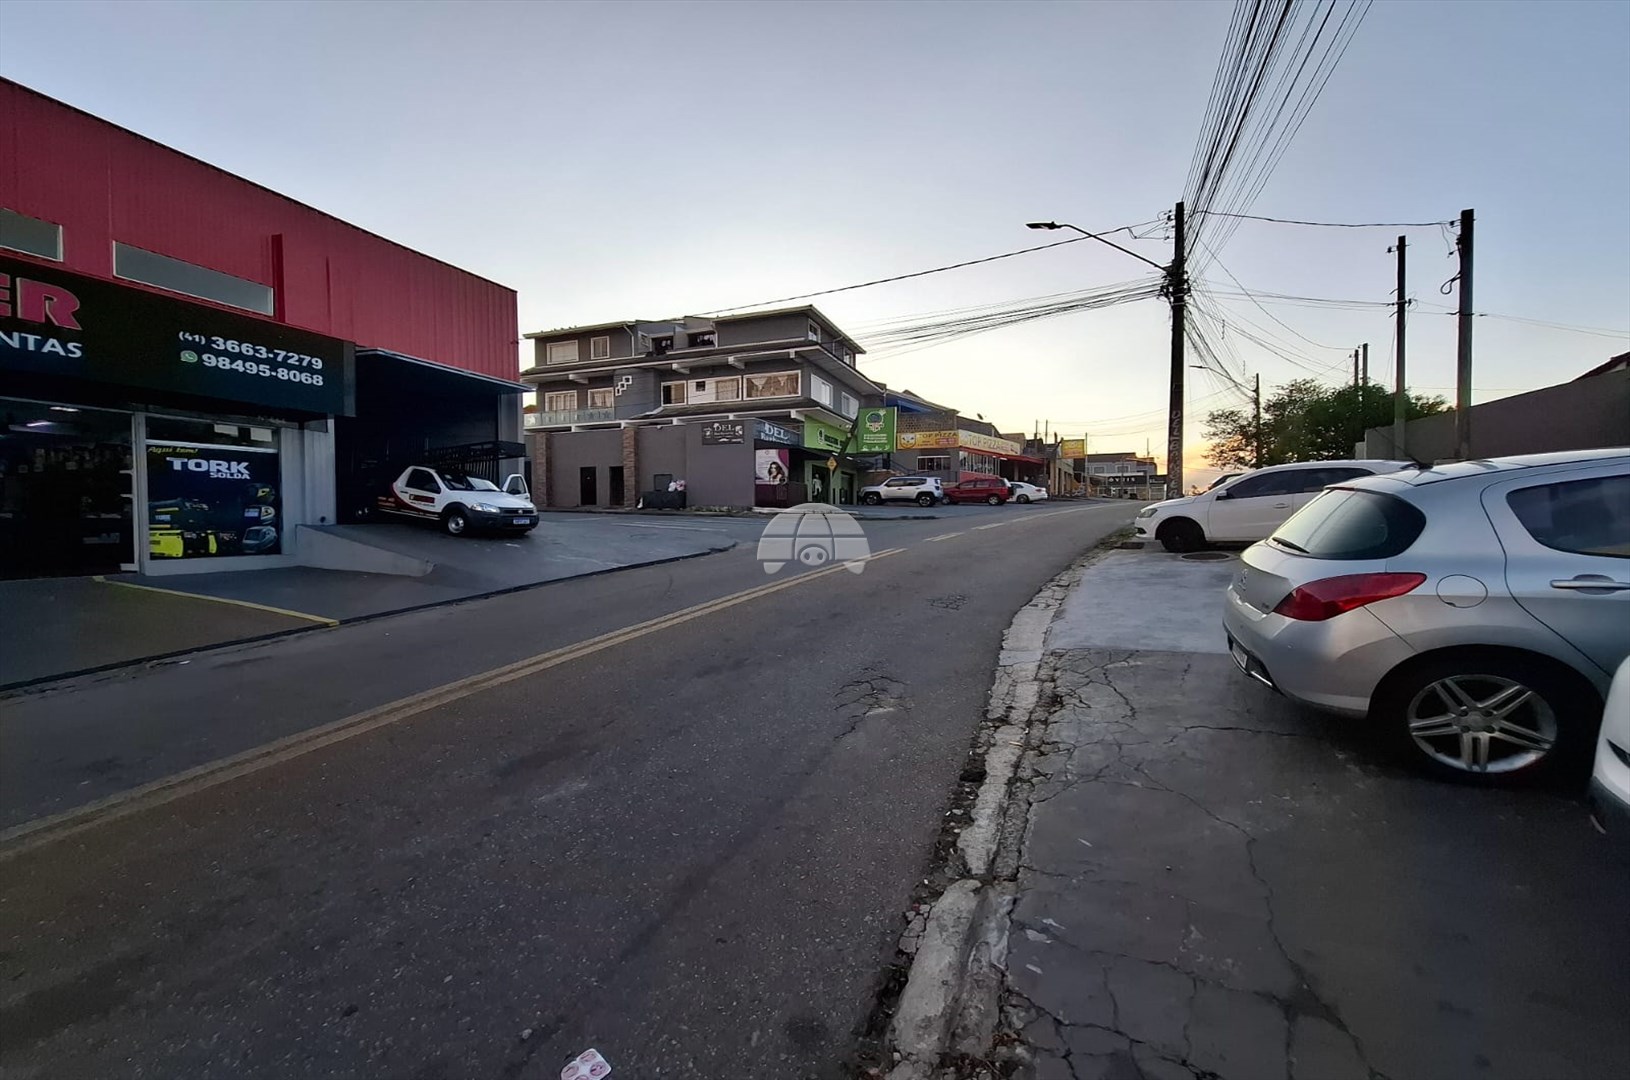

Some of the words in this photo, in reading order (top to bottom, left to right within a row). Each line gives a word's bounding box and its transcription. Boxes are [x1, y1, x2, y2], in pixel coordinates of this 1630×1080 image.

[0, 272, 83, 330] R
[178, 331, 206, 345] (41)
[211, 336, 323, 370] 3663-7279
[202, 353, 324, 386] 98495-8068
[764, 422, 790, 440] DEL
[968, 434, 982, 447] TOP
[166, 457, 250, 474] TORK
